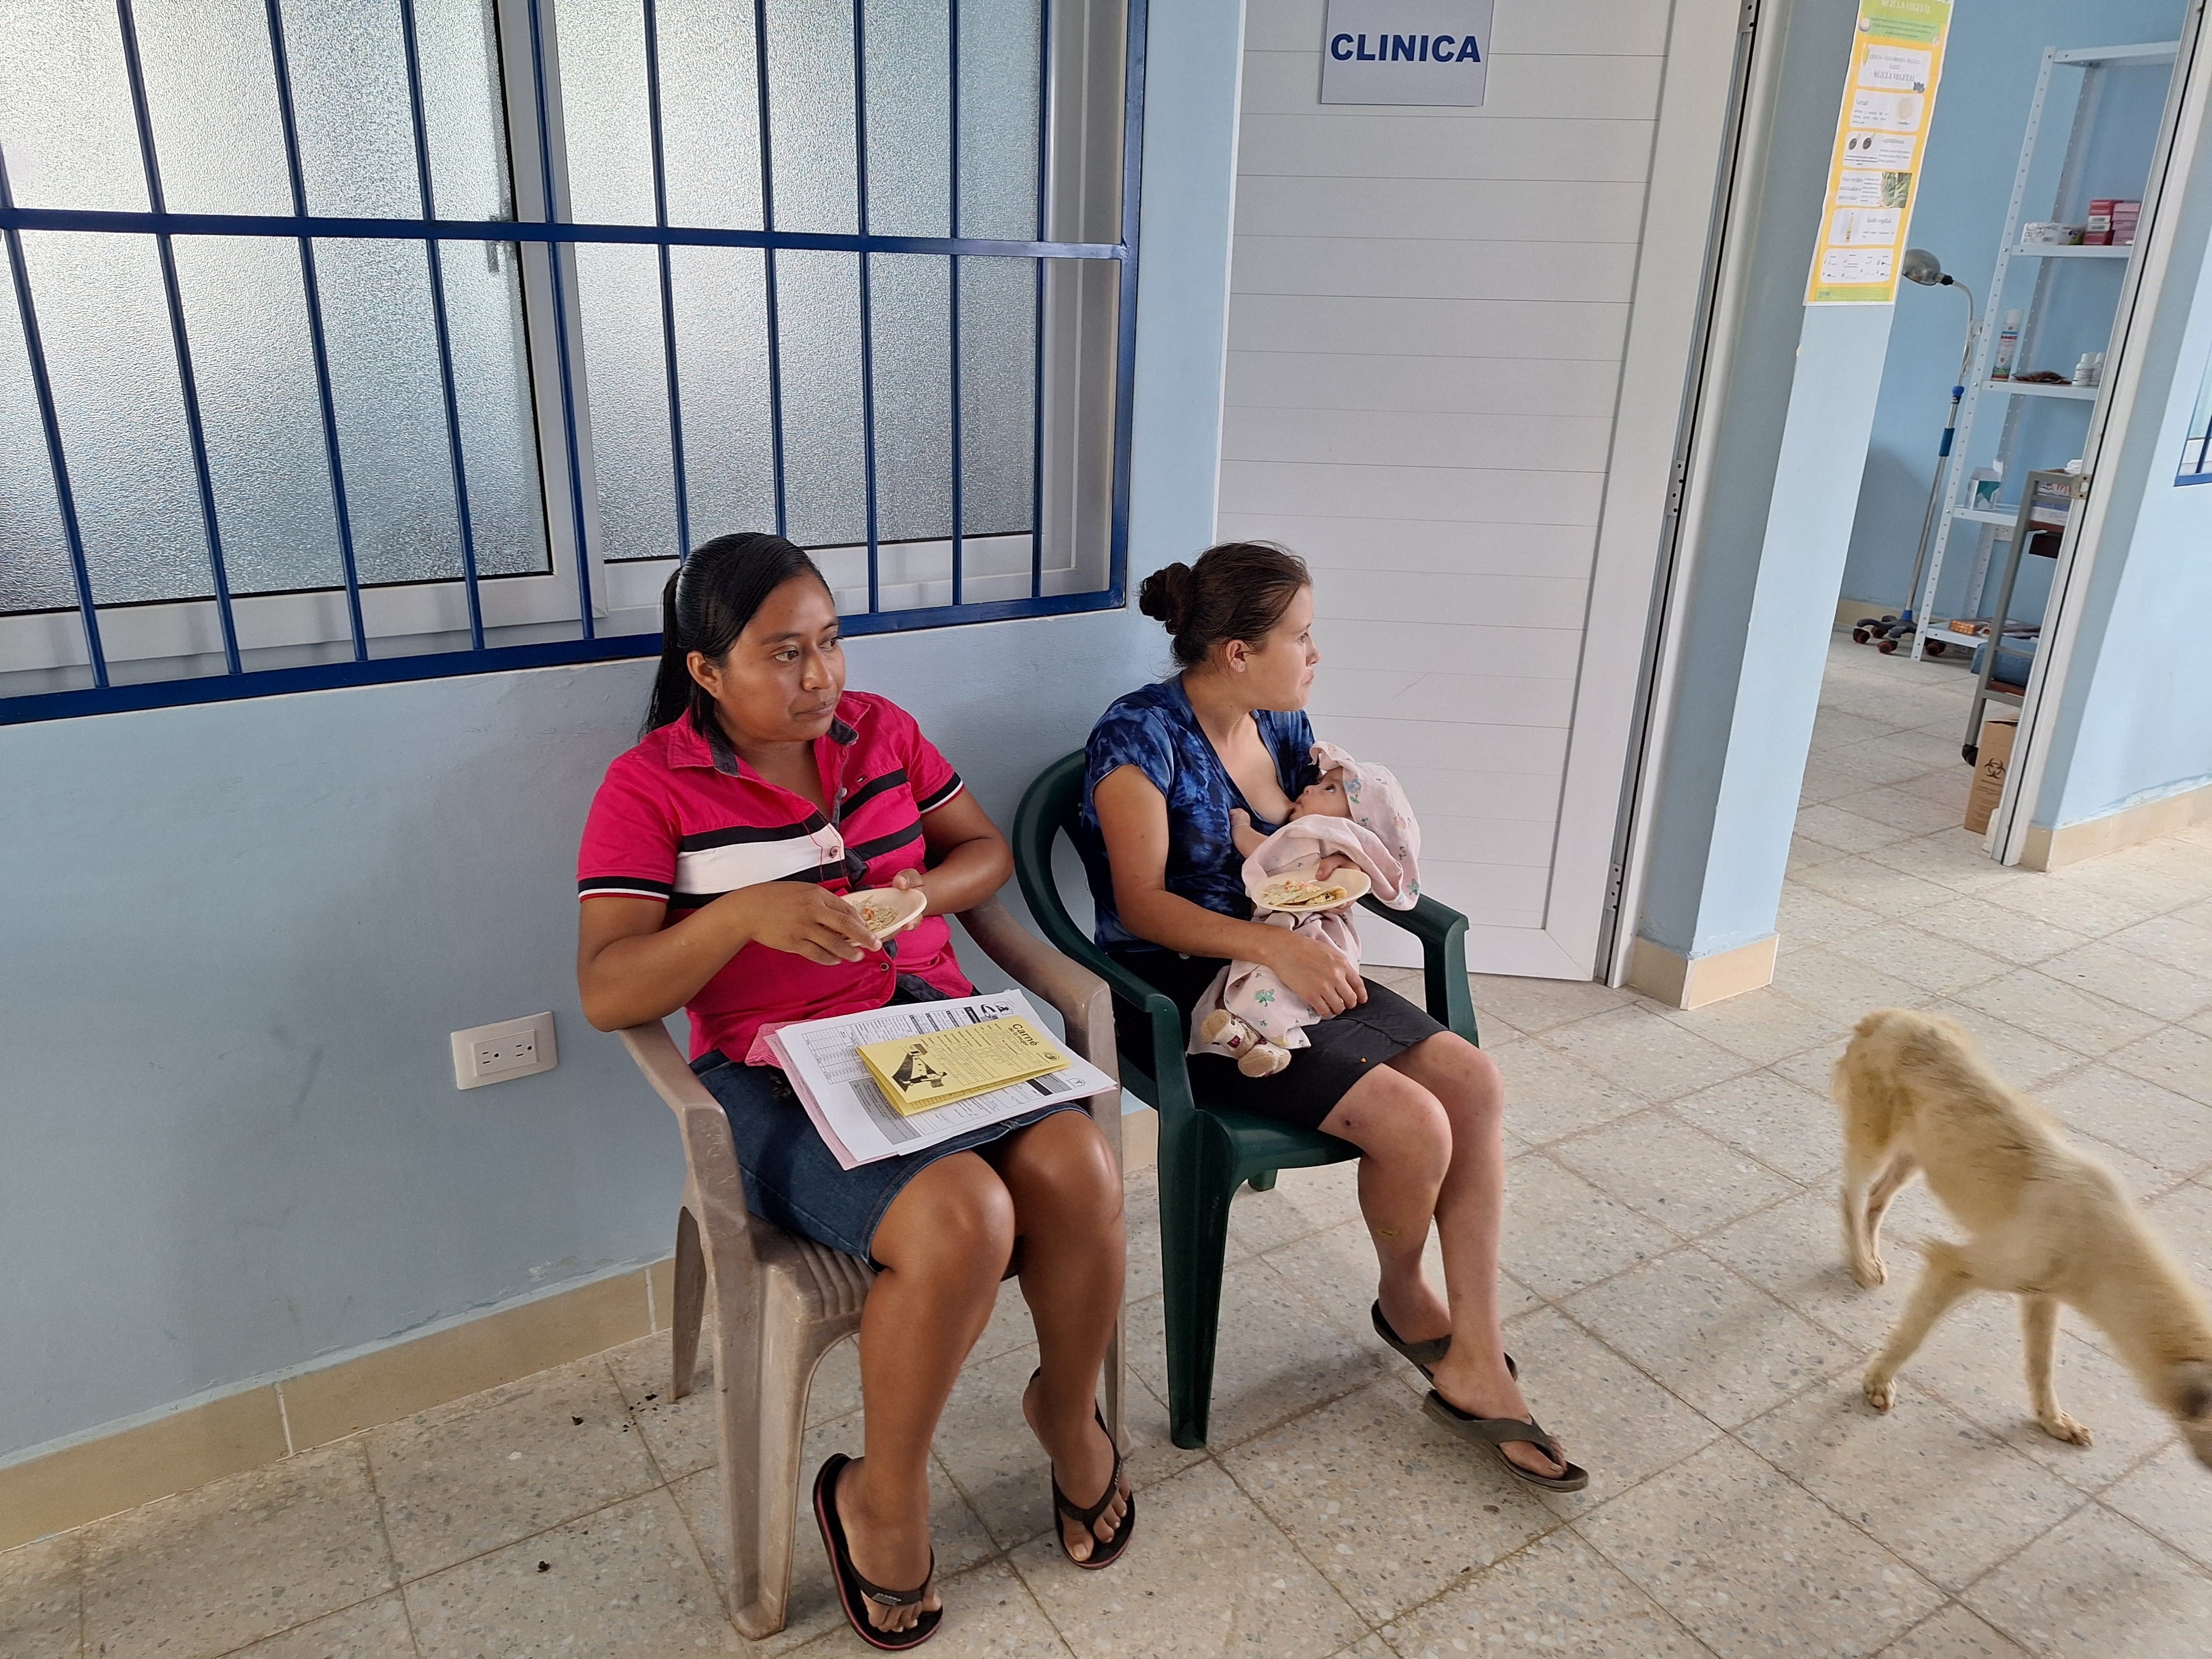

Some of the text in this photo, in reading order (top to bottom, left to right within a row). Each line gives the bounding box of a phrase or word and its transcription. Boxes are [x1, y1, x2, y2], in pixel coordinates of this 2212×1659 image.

[1331, 33, 1481, 62] CLINICA
[1874, 70, 1915, 82] MEZCLA VEGETAL
[1012, 1024, 1039, 1045] Carné
[1016, 1036, 1029, 1046] mujer
